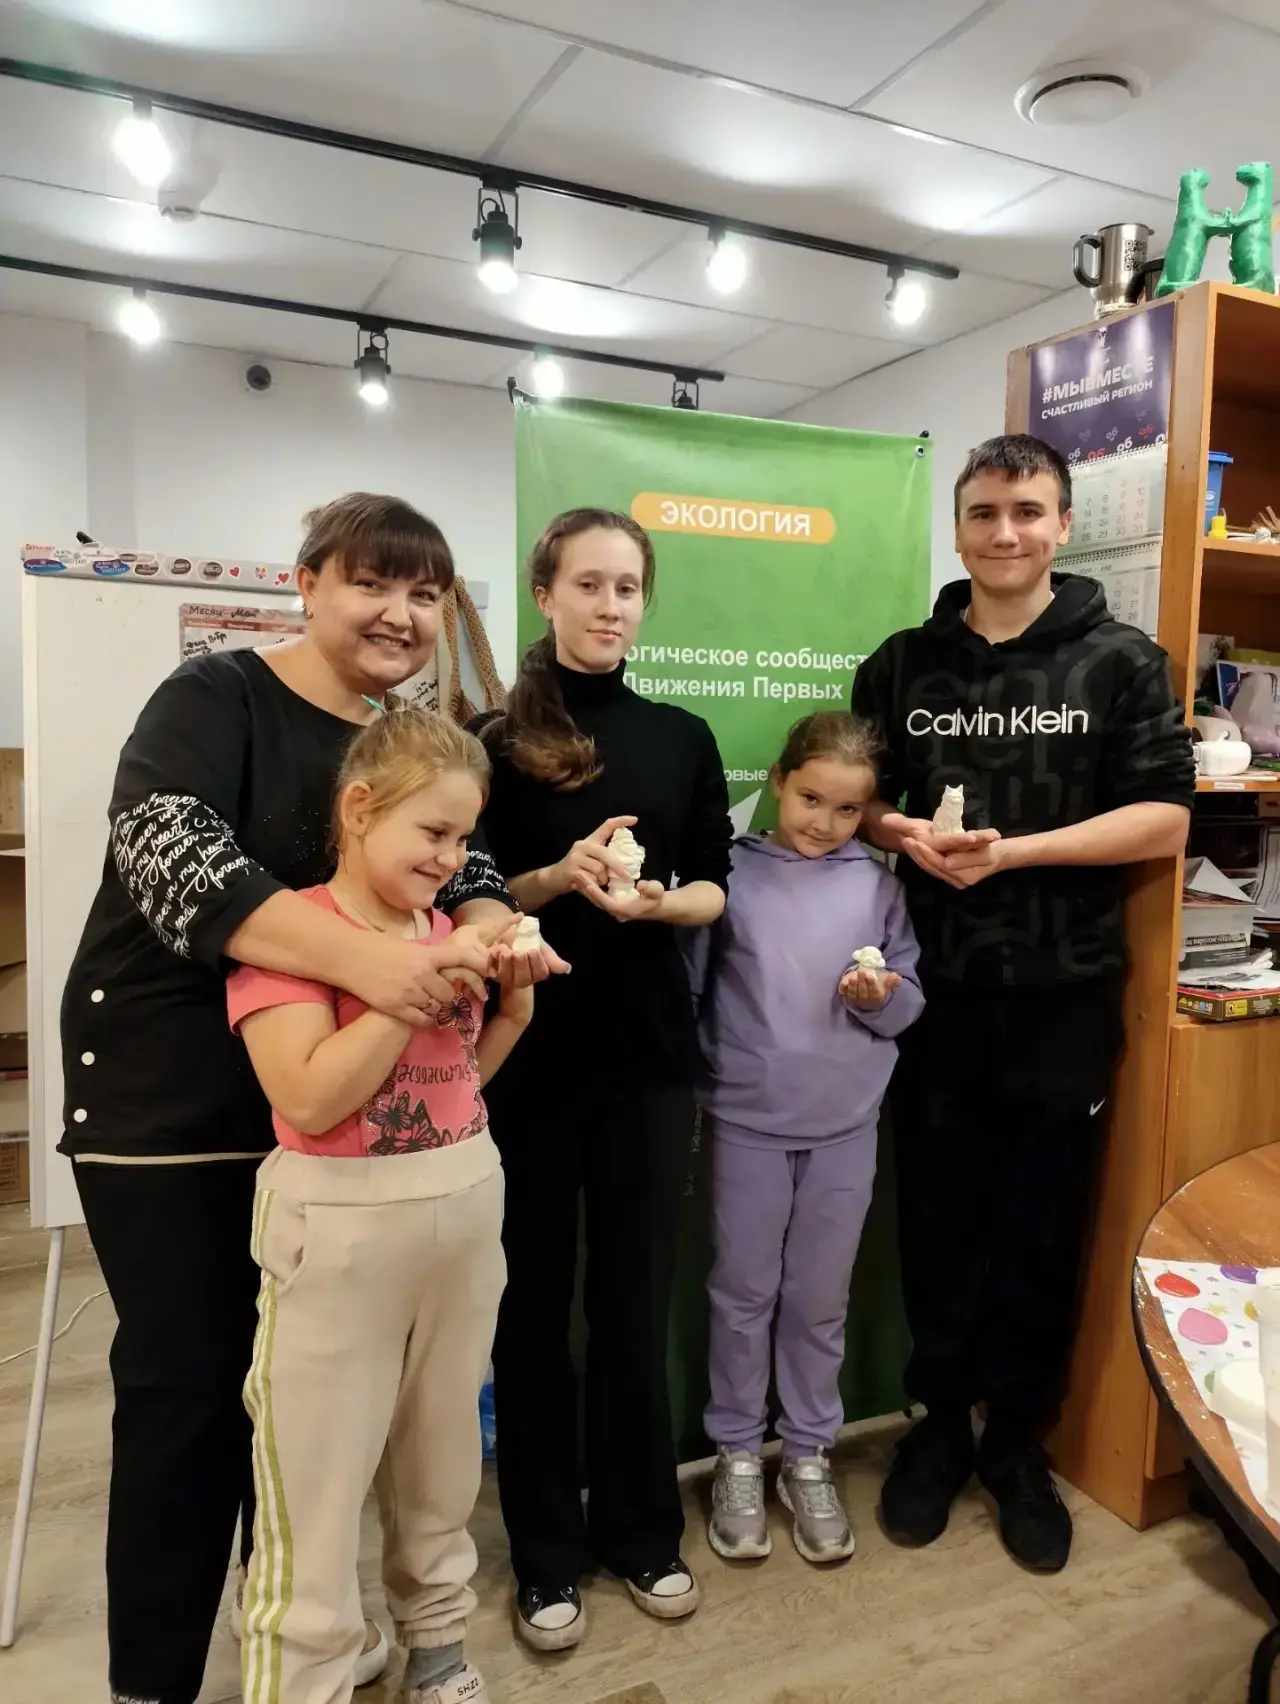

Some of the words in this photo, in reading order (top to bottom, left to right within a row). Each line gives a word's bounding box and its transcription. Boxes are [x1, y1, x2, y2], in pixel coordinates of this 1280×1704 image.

[1041, 355, 1154, 404] #МЫВМЕСЕ
[1041, 390, 1110, 420] СЧАСТЛИВЫЙ
[1111, 379, 1153, 400] РЕГИОН
[660, 500, 811, 537] ЭКОЛОГИЯ
[623, 671, 745, 697] Движения
[753, 676, 844, 704] Первых
[906, 705, 1004, 737] Calvin
[1010, 703, 1089, 736] Klein
